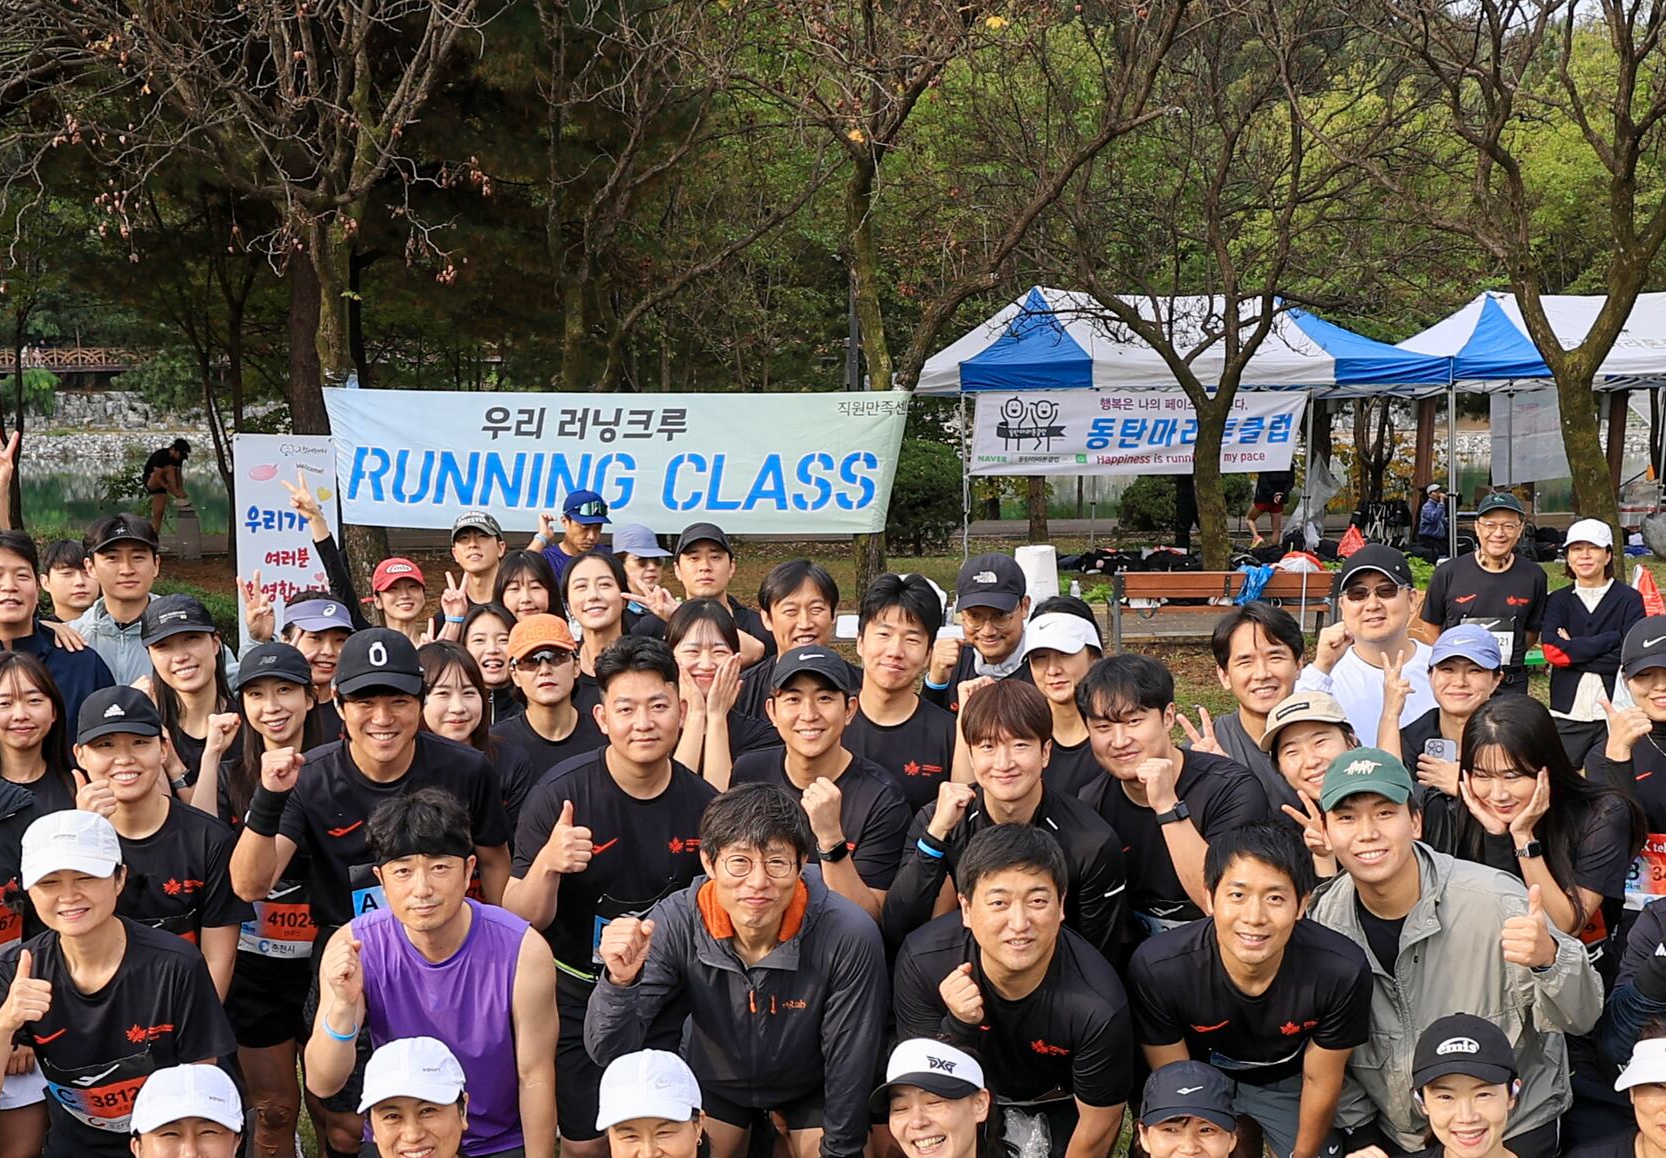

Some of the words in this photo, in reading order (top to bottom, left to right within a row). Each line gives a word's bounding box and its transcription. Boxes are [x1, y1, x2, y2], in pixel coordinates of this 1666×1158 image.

[837, 400, 909, 416] 직원만족센
[1100, 398, 1133, 410] 행복은
[1139, 398, 1161, 410] 나의
[482, 407, 546, 440] 우리
[558, 407, 687, 443] 러닝크루
[978, 455, 1007, 463] NAVER
[1097, 455, 1150, 466] Happiness
[1153, 454, 1163, 464] is
[1223, 453, 1238, 463] my
[1240, 452, 1266, 463] pace
[347, 446, 636, 510] RUNNING
[663, 451, 879, 510] CLASS
[245, 504, 309, 534] 우리가
[264, 547, 310, 568] 여러분
[361, 893, 379, 914] A
[1436, 1037, 1480, 1055] emis
[57, 1088, 77, 1104] C
[90, 1087, 141, 1108] 3812
